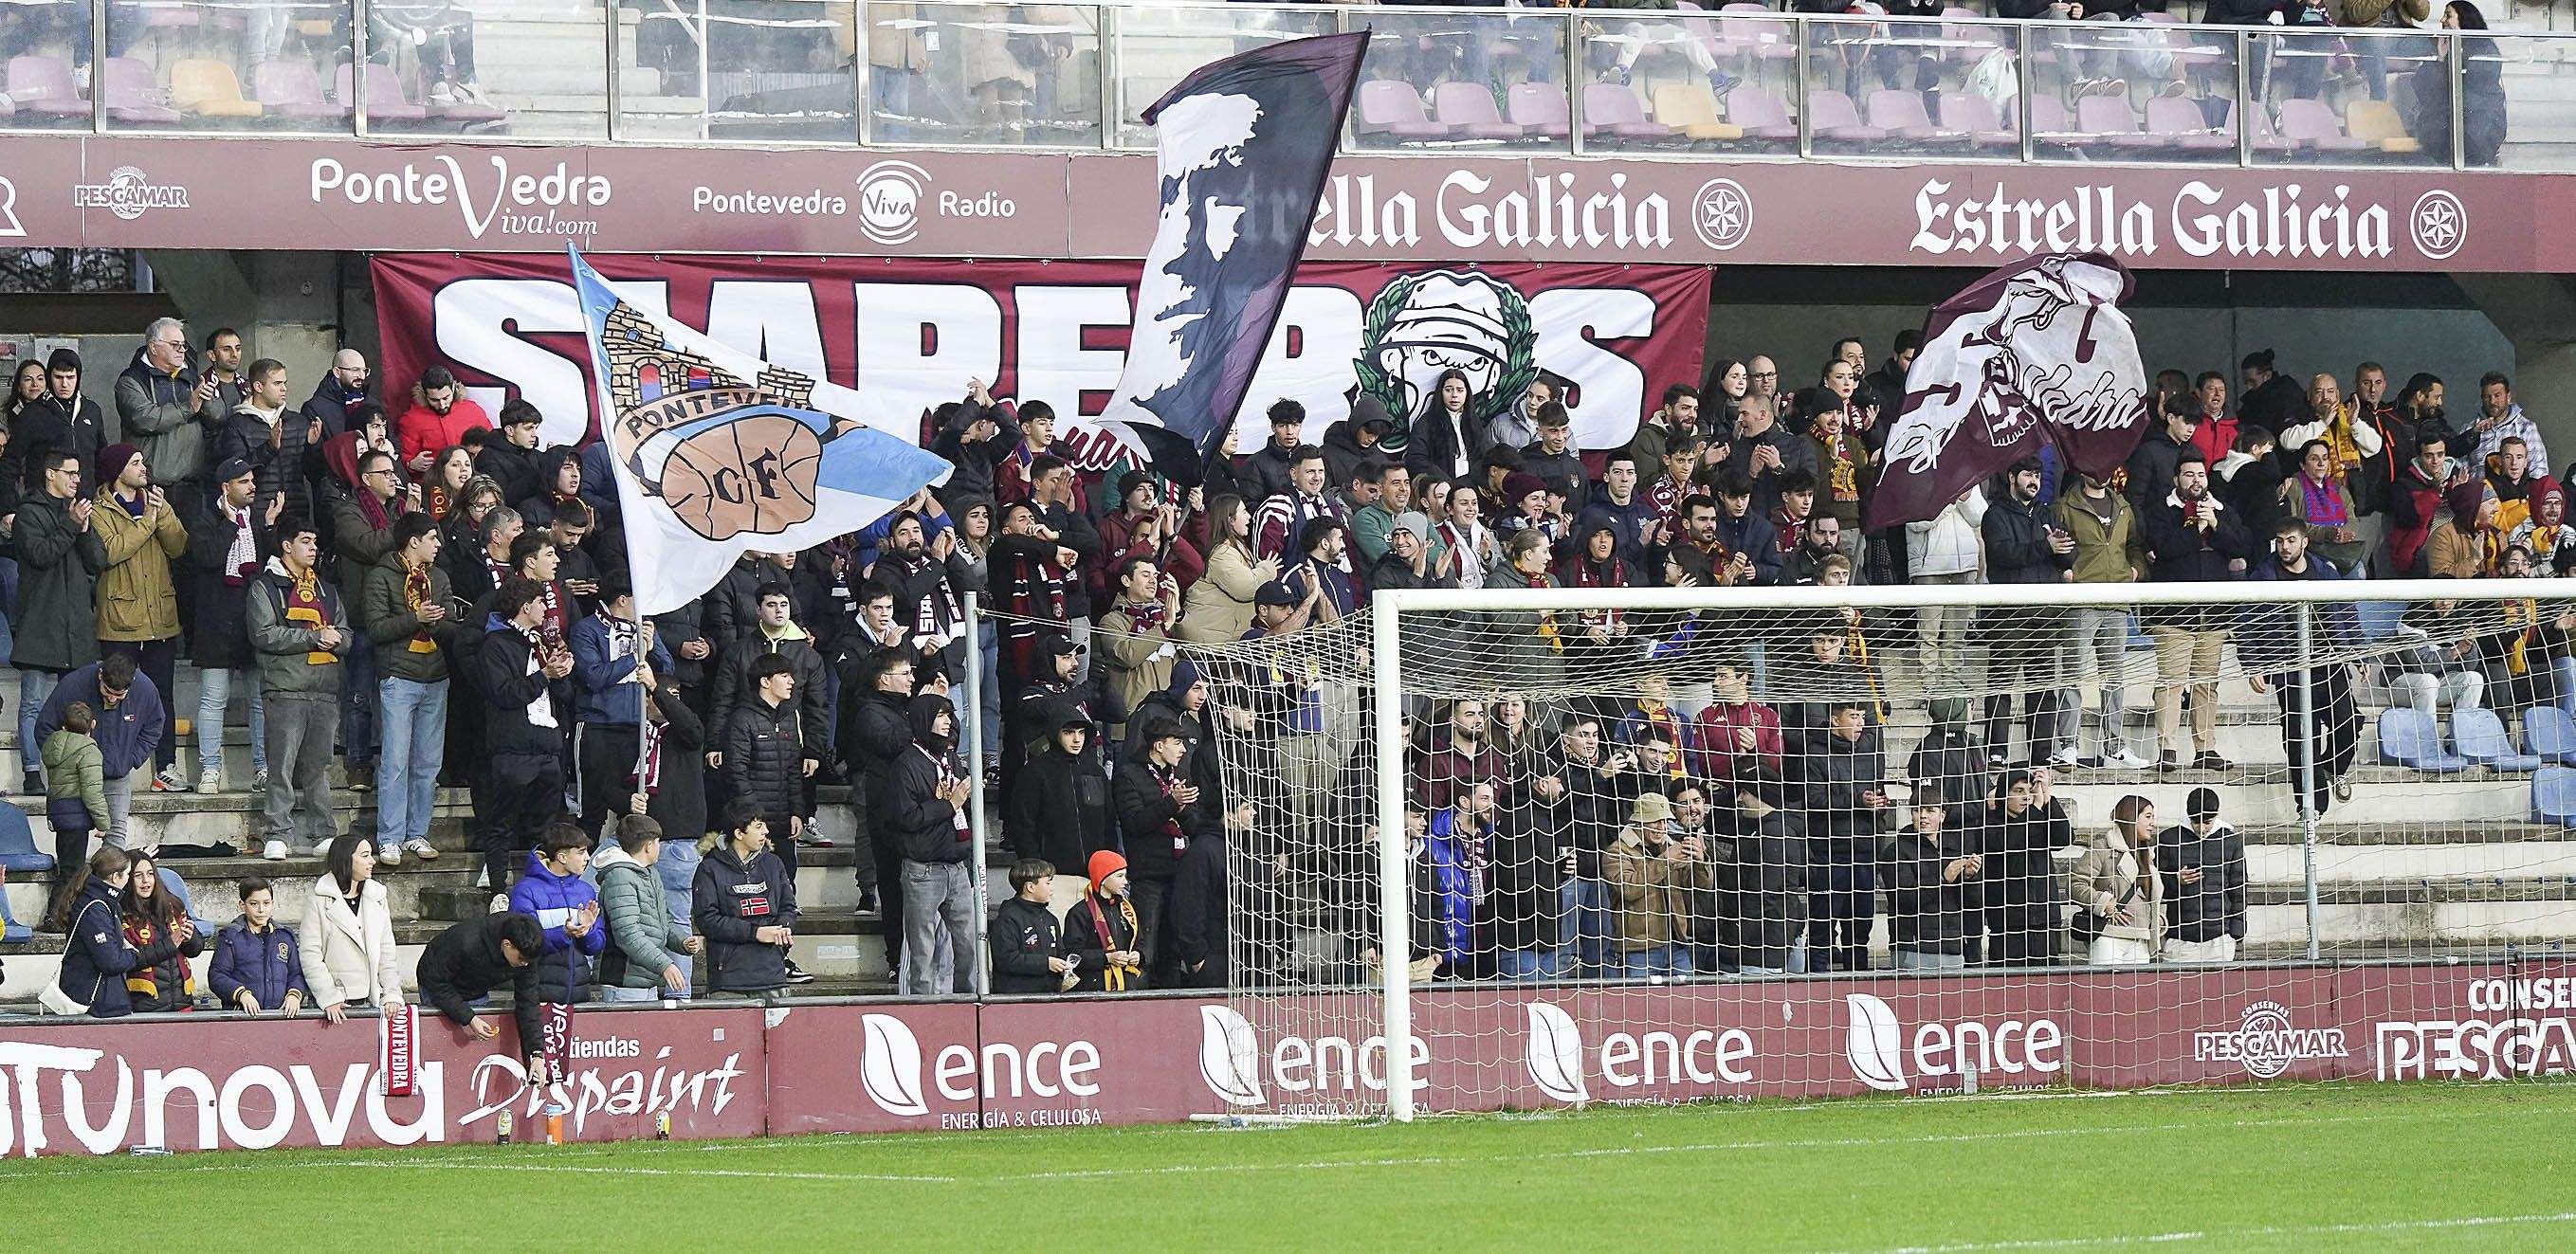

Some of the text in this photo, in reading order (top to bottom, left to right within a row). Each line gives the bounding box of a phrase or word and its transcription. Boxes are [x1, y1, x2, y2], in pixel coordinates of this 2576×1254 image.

[75, 185, 190, 208] PESCAMAR
[693, 187, 1016, 218] Pontevedra Viva Radio
[1436, 169, 1674, 250] Galicia
[1909, 177, 2393, 260] Estrella Galicia
[2241, 1000, 2290, 1018] CONSERVAS
[569, 1036, 639, 1059] tiendas
[1601, 1027, 1755, 1087] ence
[1913, 1018, 2062, 1077] ence
[2194, 1028, 2349, 1062] PESCAMAR
[934, 1040, 1102, 1101] ence
[941, 1108, 1103, 1130] ENERGÍA & CELULOSA
